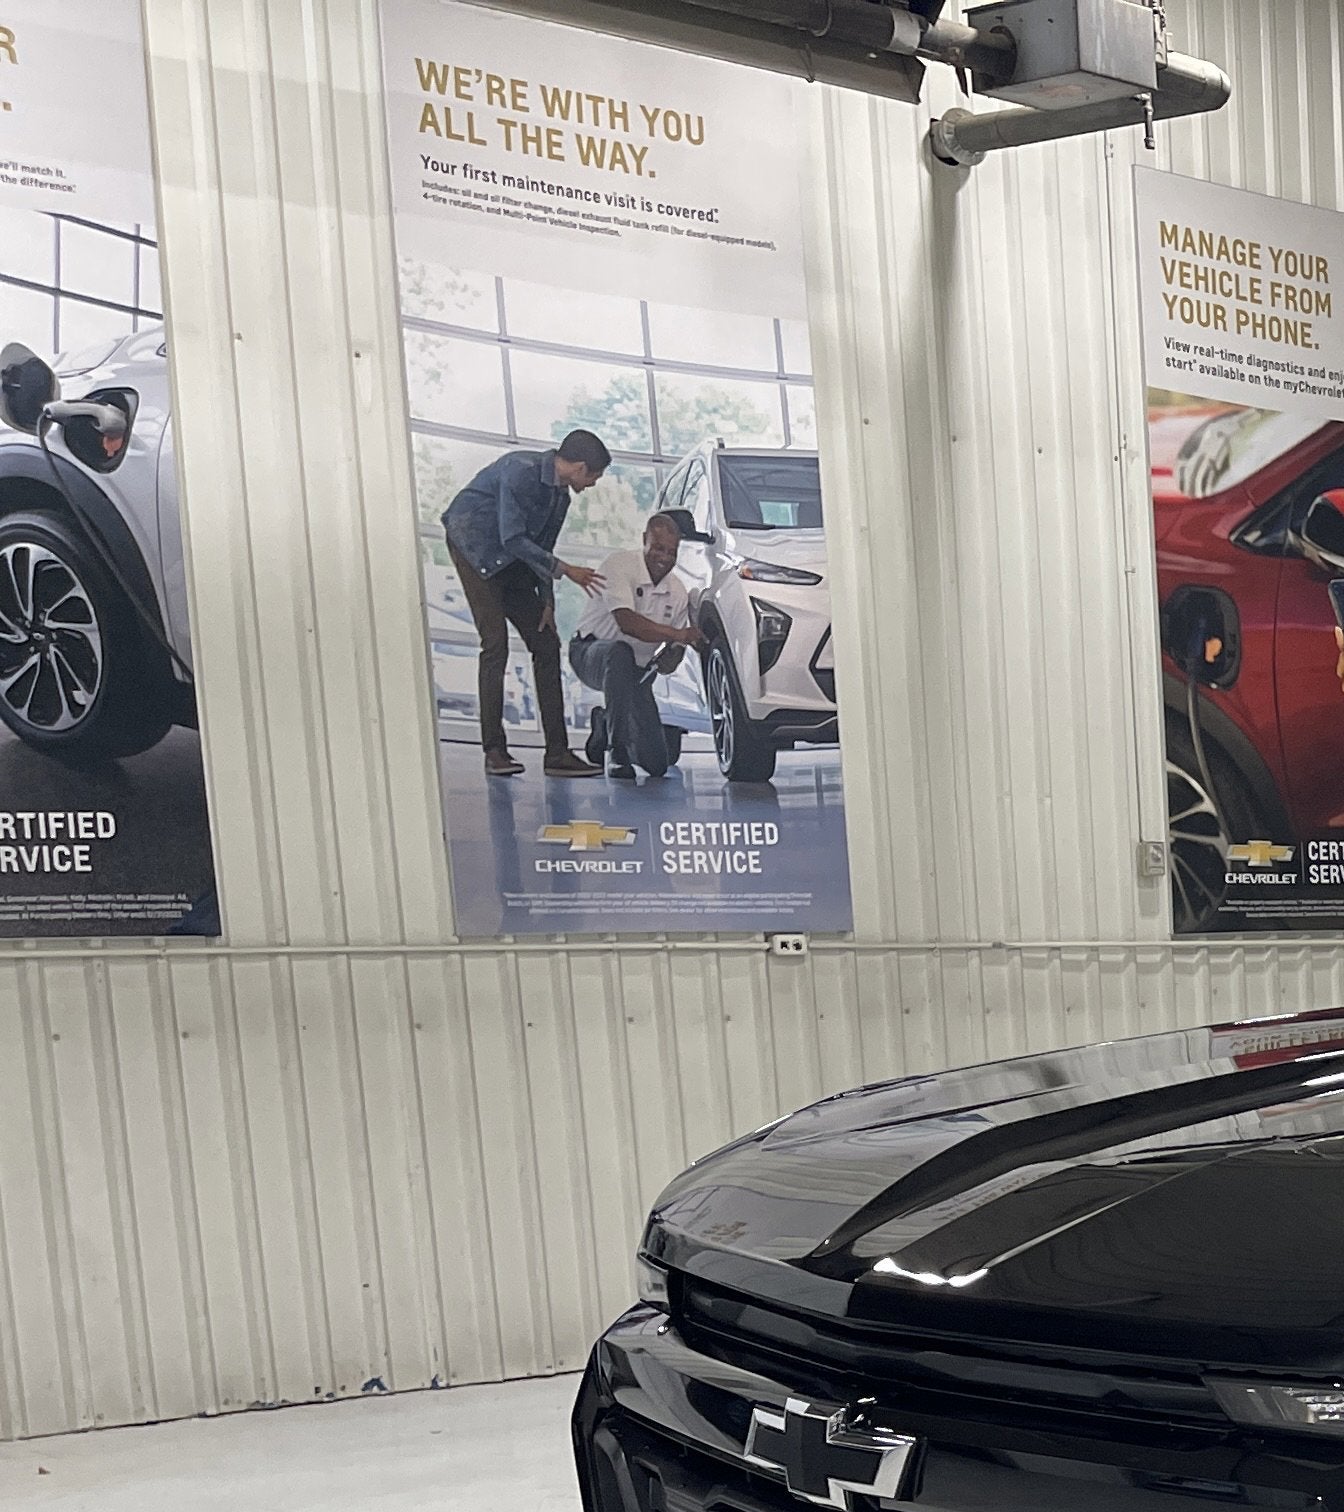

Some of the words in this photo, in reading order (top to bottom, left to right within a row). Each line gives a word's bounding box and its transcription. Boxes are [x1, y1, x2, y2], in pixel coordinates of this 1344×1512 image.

[414, 57, 530, 113] WE'RE
[540, 84, 630, 133] WITH
[639, 104, 705, 146] YOU
[419, 101, 487, 146] ALL
[497, 117, 565, 162] THE
[575, 133, 656, 178] WAY.
[0, 160, 18, 172] e'll
[21, 164, 53, 178] match
[420, 153, 457, 176] Your
[463, 163, 498, 185] first
[502, 174, 601, 203] maintenance
[604, 191, 637, 211] visit
[641, 196, 653, 213] is
[1160, 221, 1262, 270] MANAGE
[1268, 246, 1329, 284] YOUR
[1160, 256, 1263, 305] VEHICLE
[1270, 282, 1332, 318] FROM
[1162, 292, 1228, 333] YOUR
[1235, 309, 1320, 350] PHONE.
[1164, 336, 1190, 353] View
[1193, 343, 1244, 365] real-time
[1247, 353, 1305, 377] diagnostics
[1307, 365, 1326, 379] and
[1199, 362, 1245, 382] available
[1248, 373, 1261, 385] on
[1264, 373, 1281, 389] the
[659, 821, 779, 846] CERTIFIED
[534, 859, 644, 874] CHEVROLET
[662, 850, 762, 874] SERVICE
[1225, 873, 1298, 885] CHEVROLET
